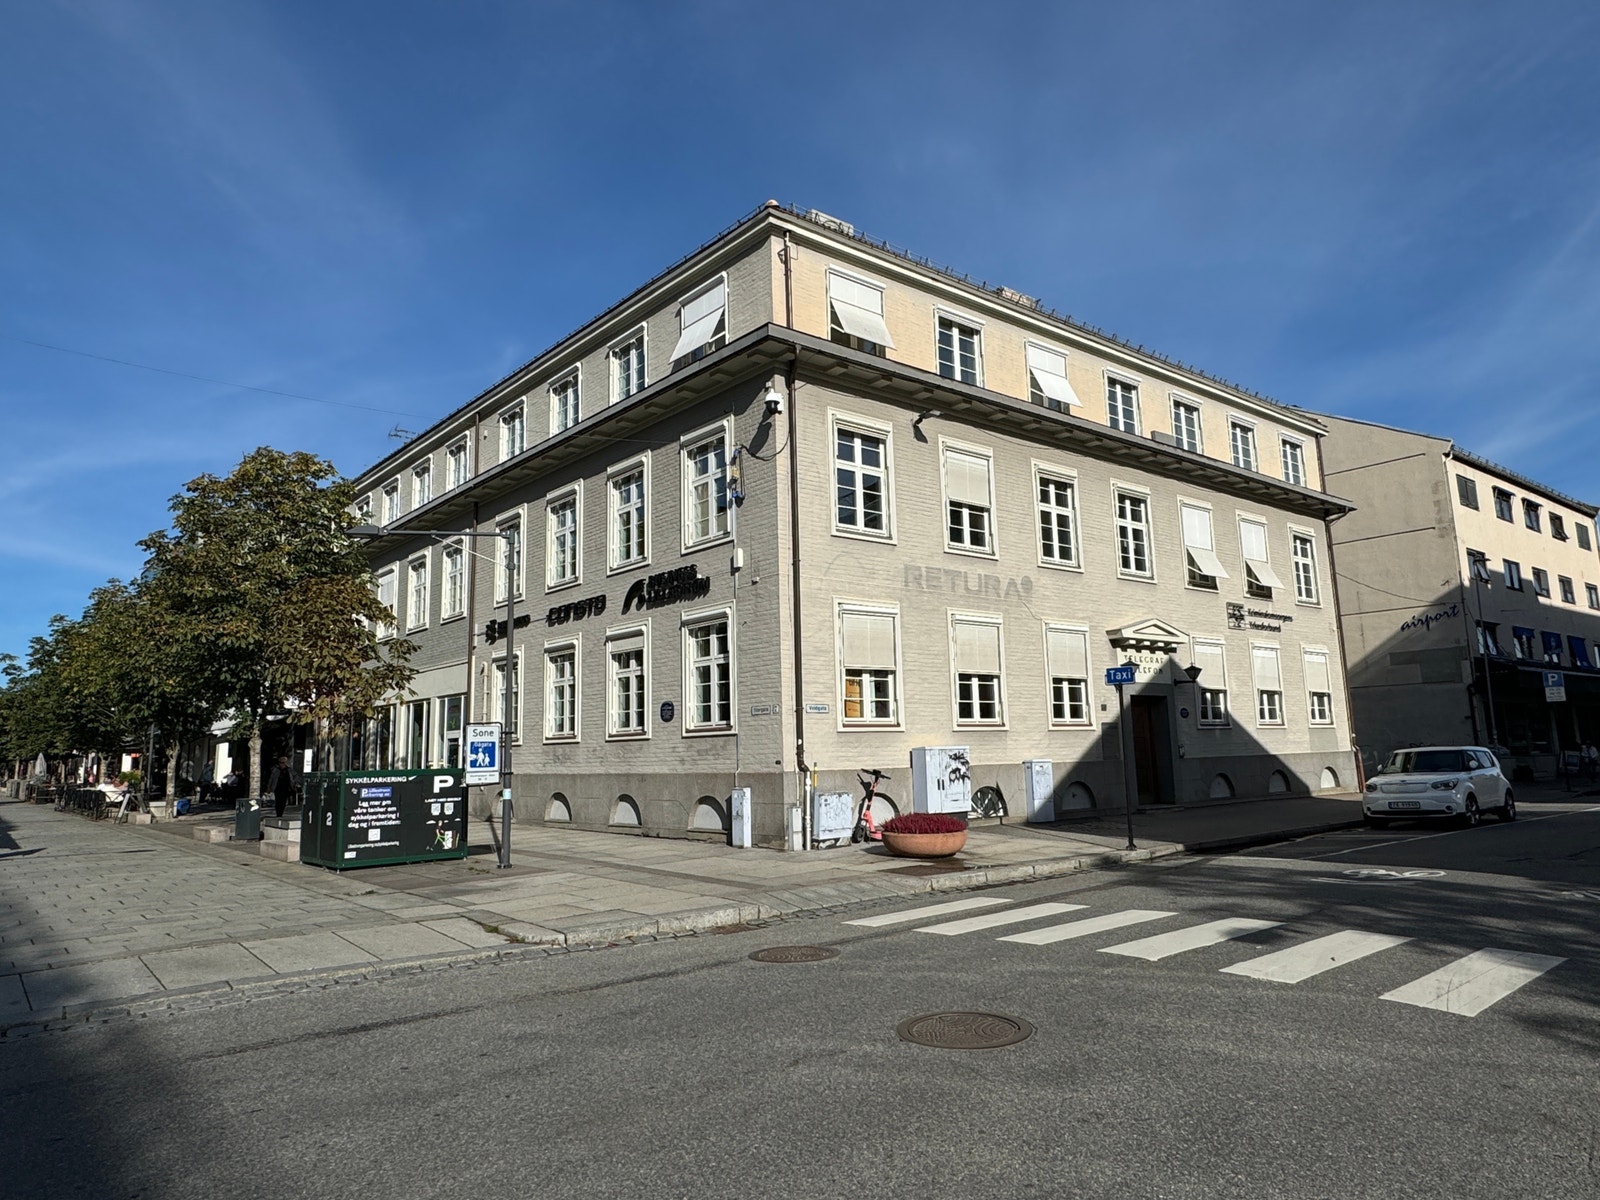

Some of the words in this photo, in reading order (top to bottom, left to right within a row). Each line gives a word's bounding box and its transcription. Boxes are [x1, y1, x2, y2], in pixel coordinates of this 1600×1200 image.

[904, 563, 1022, 600] RETURA
[1400, 604, 1460, 631] airport
[1108, 668, 1132, 681] Taxi
[1547, 673, 1558, 686] P
[472, 728, 495, 738] Sone
[345, 776, 407, 785] SYKKELPARKERING
[433, 775, 455, 794] P
[308, 810, 313, 824] 1
[325, 811, 333, 826] 2
